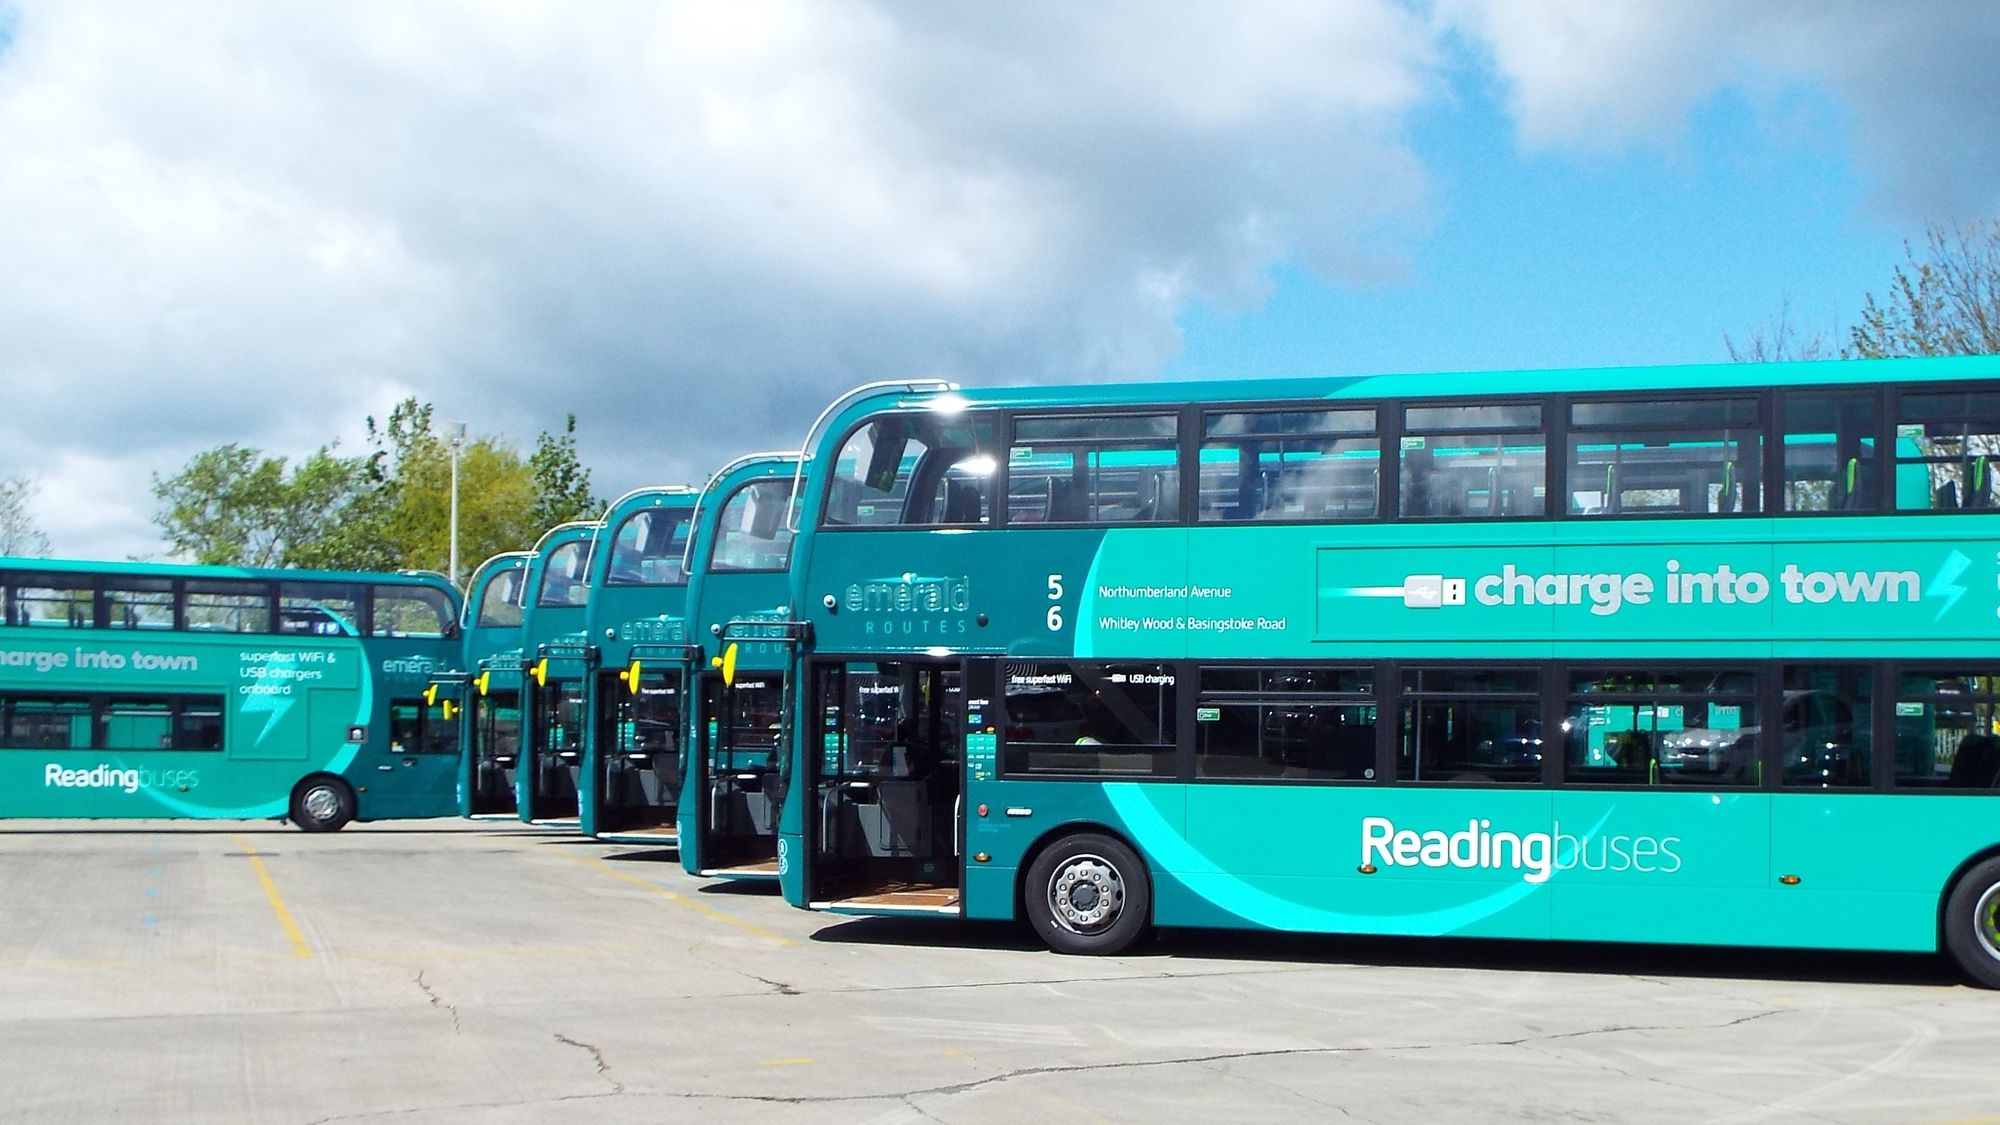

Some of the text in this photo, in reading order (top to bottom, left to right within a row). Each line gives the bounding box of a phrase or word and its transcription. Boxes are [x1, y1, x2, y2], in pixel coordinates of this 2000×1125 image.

[845, 575, 970, 612] emerald
[1048, 574, 1064, 600] 5
[1099, 586, 1232, 598] Northumberland Avenue
[1474, 559, 1921, 616] charge into town
[1047, 605, 1063, 631] 6
[1099, 617, 1286, 633] Whitley Wood & Basingstoke Road
[866, 620, 966, 633] ROUTES
[75, 647, 126, 669] into
[131, 651, 197, 670] town
[240, 651, 296, 663] superfast
[327, 652, 336, 663] &
[240, 667, 322, 681] USB chargers
[1011, 675, 1072, 685] free superfast WiFi
[1129, 674, 1175, 686] USB charging
[239, 683, 291, 695] onboard
